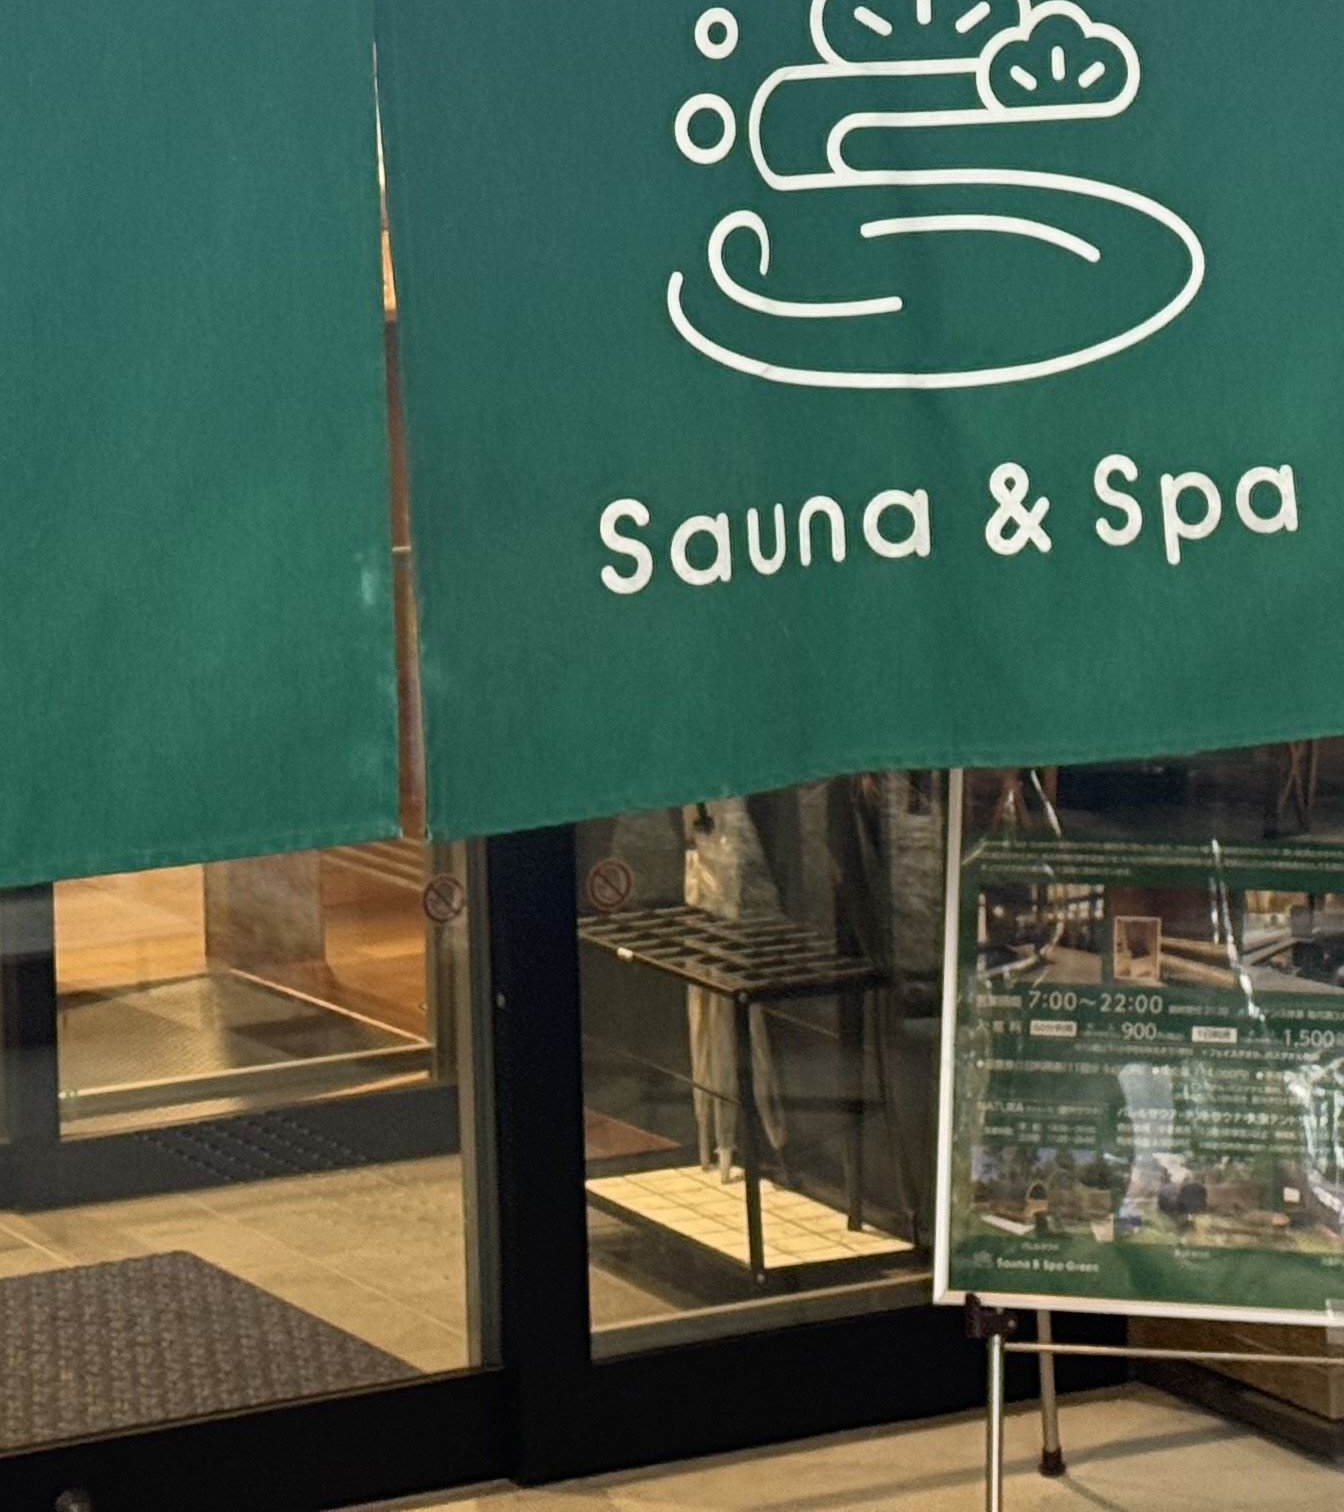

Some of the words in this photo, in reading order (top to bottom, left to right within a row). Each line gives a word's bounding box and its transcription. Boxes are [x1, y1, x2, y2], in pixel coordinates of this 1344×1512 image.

[598, 488, 931, 595] Sauna
[984, 462, 1052, 556] &
[1093, 453, 1299, 565] Spa
[1121, 1021, 1157, 1040] 900
